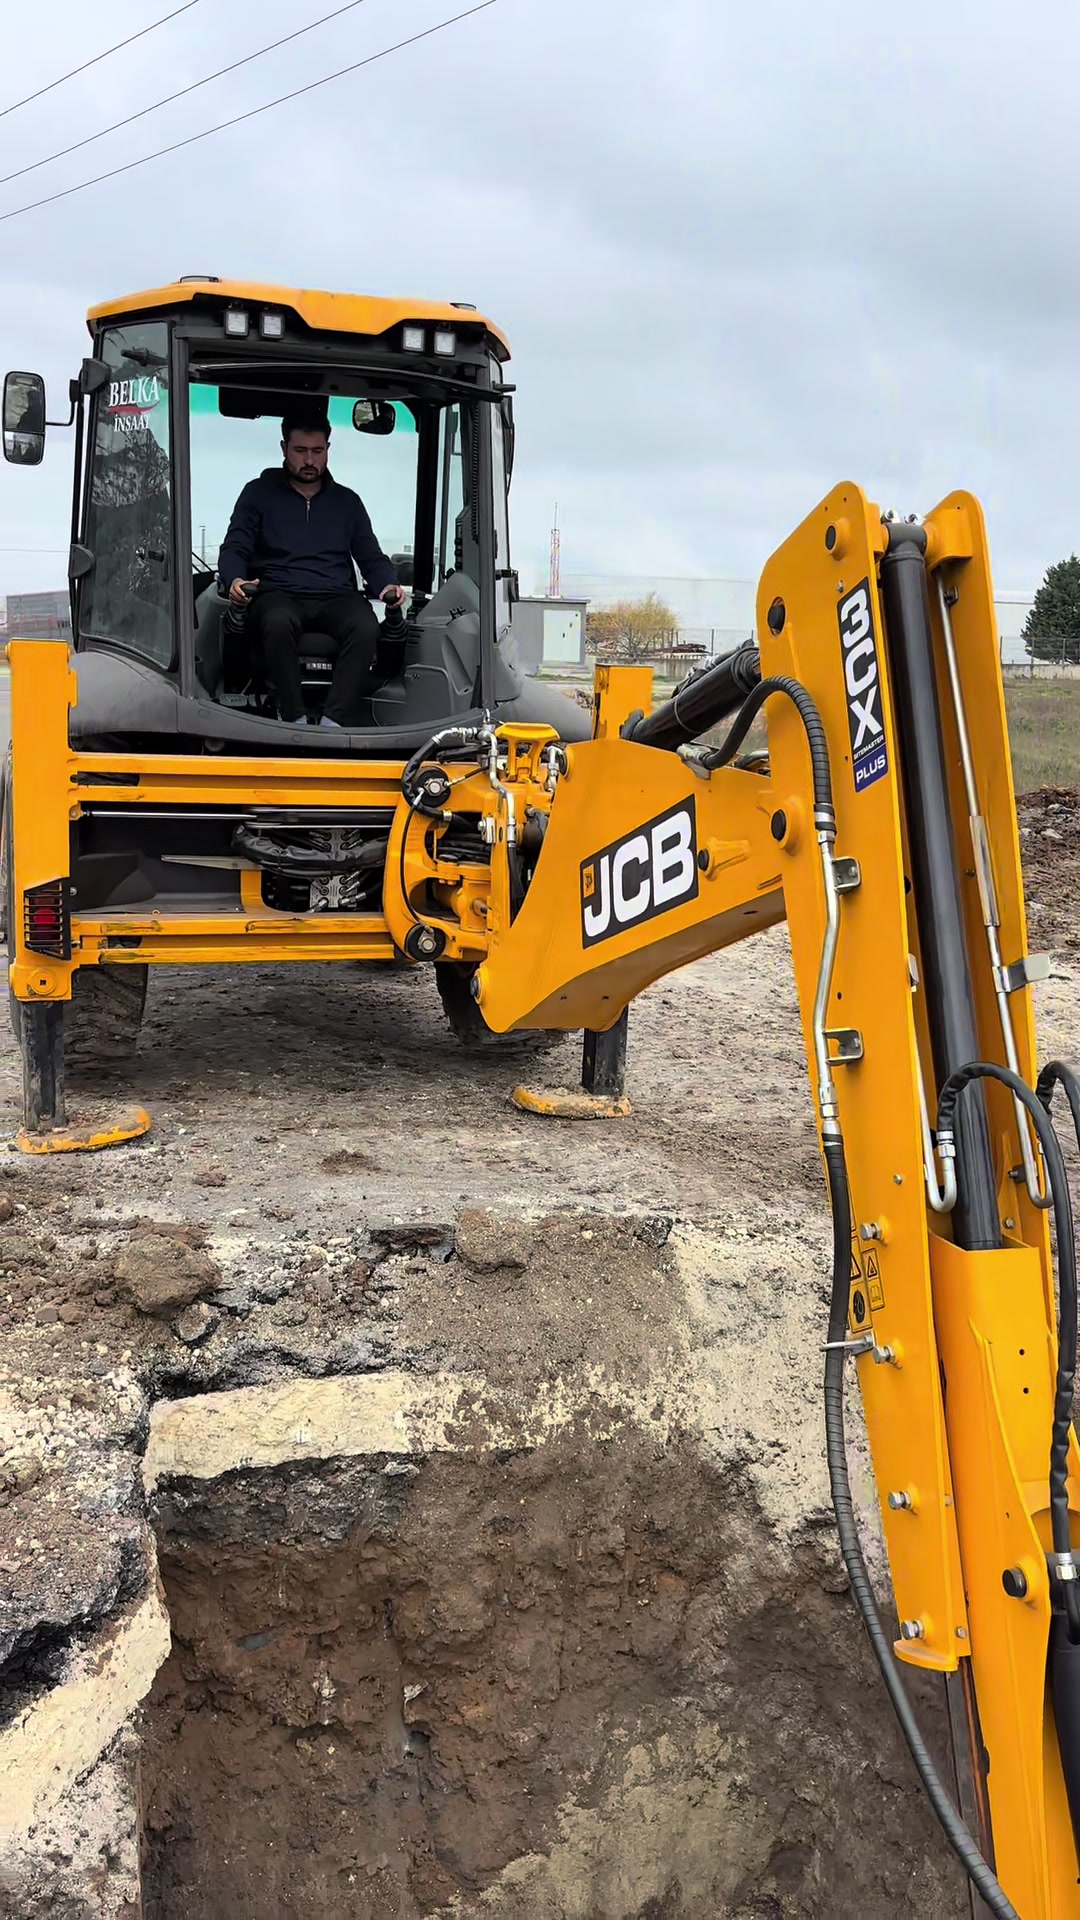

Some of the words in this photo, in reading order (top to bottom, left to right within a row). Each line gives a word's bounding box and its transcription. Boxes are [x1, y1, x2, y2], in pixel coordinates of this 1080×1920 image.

[108, 376, 160, 407] BELKA
[840, 588, 883, 750] 3CX
[853, 734, 884, 760] SITEMASTER
[856, 754, 886, 784] PLUS
[584, 811, 694, 937] JCB
